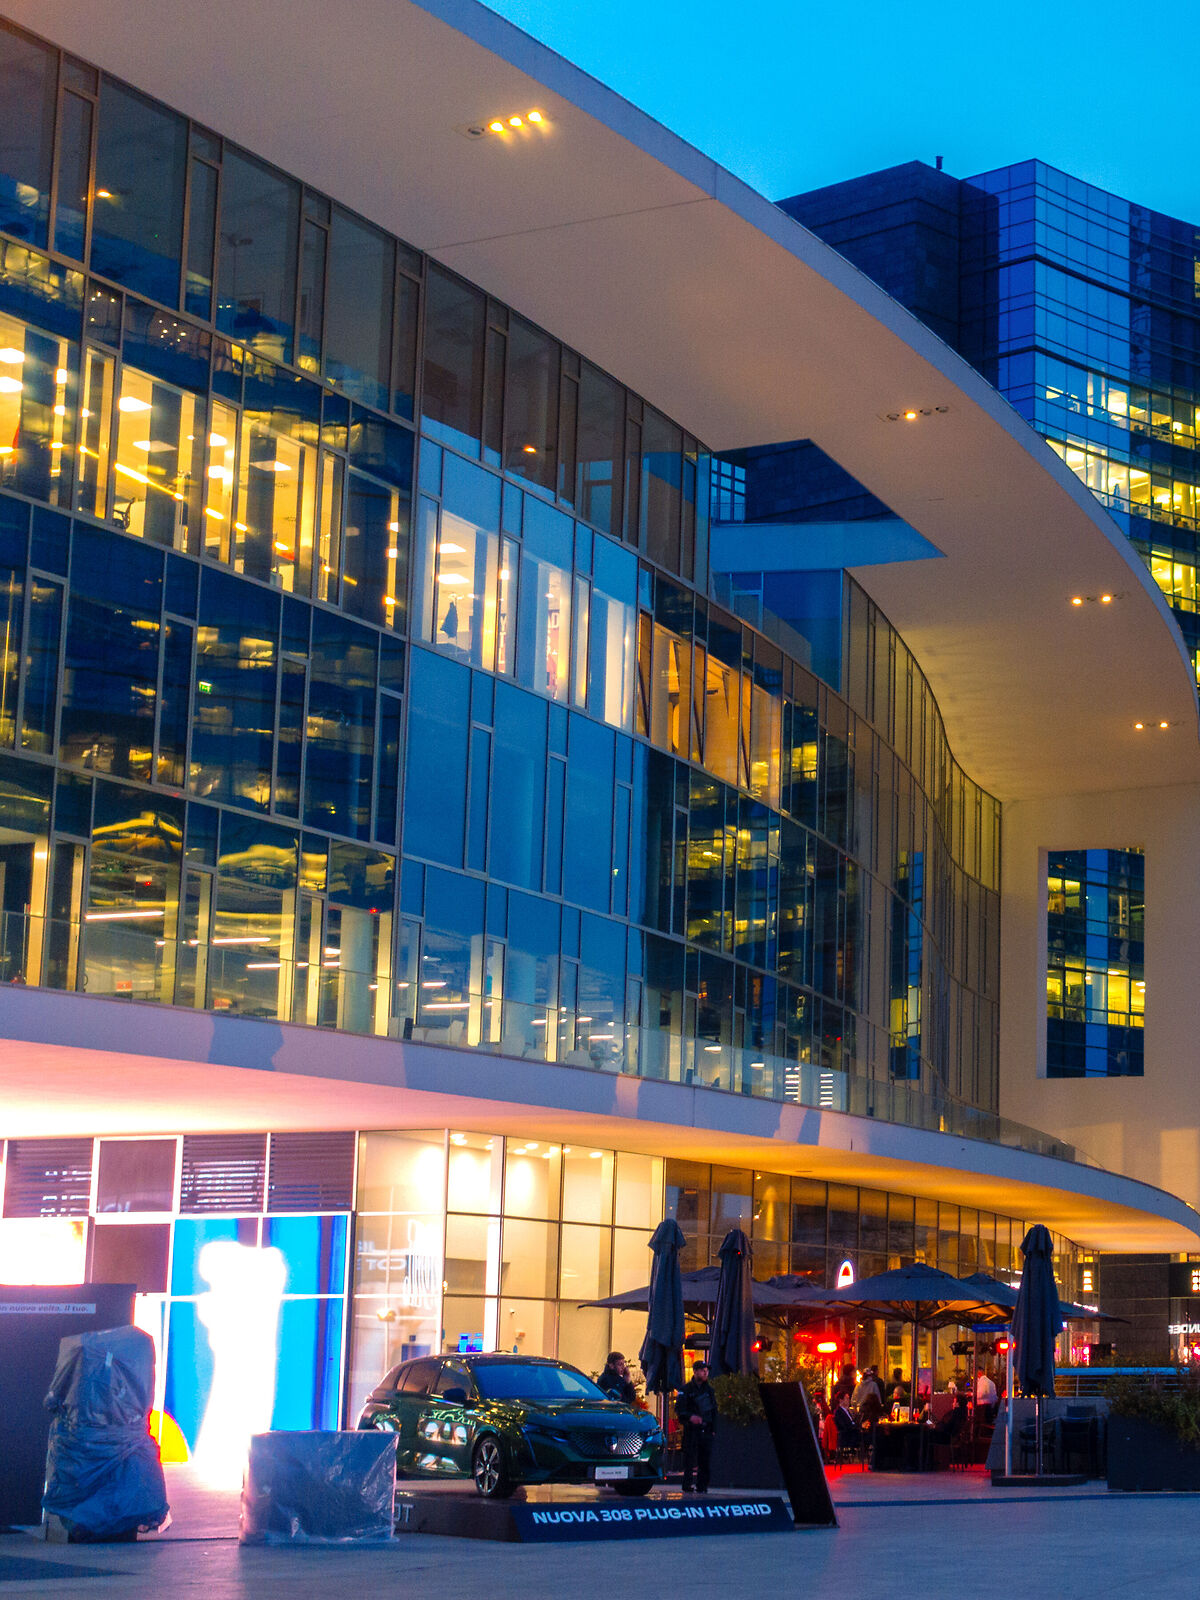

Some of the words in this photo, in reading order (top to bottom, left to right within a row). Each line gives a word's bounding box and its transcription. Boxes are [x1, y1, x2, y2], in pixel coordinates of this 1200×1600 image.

[532, 1511, 600, 1524] NUOVA
[600, 1509, 633, 1522] 308
[634, 1507, 705, 1521] PLUG-IN
[706, 1504, 772, 1518] HYBRID
